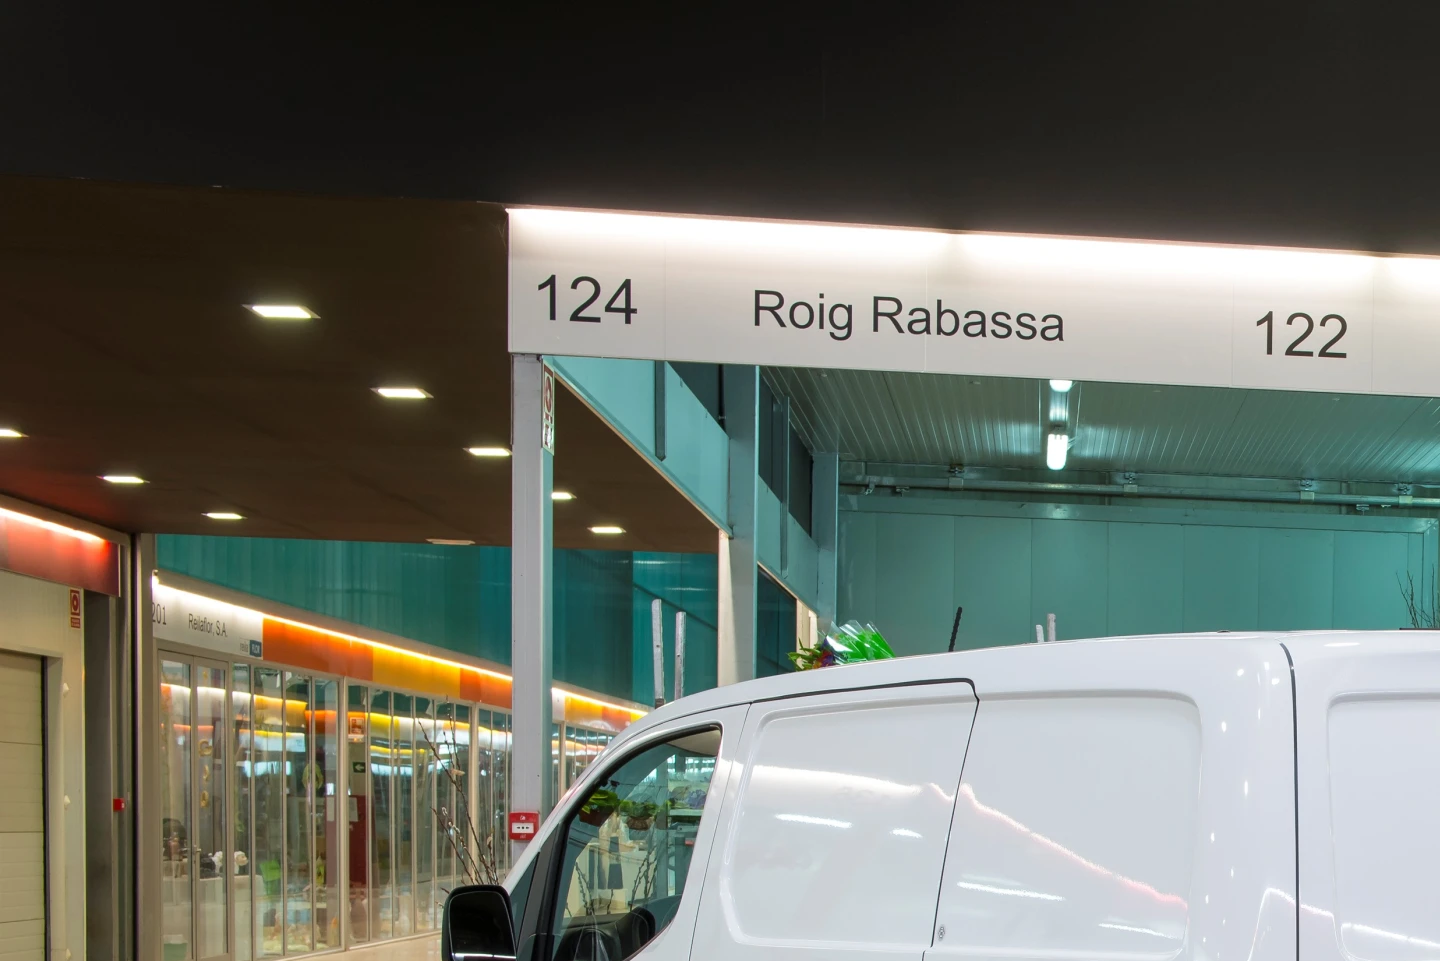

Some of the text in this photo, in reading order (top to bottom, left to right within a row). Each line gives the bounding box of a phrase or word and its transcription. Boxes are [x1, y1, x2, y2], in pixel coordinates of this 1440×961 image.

[538, 275, 637, 324] 124
[754, 289, 1064, 341] Roig Rabassa
[1256, 310, 1347, 359] 122
